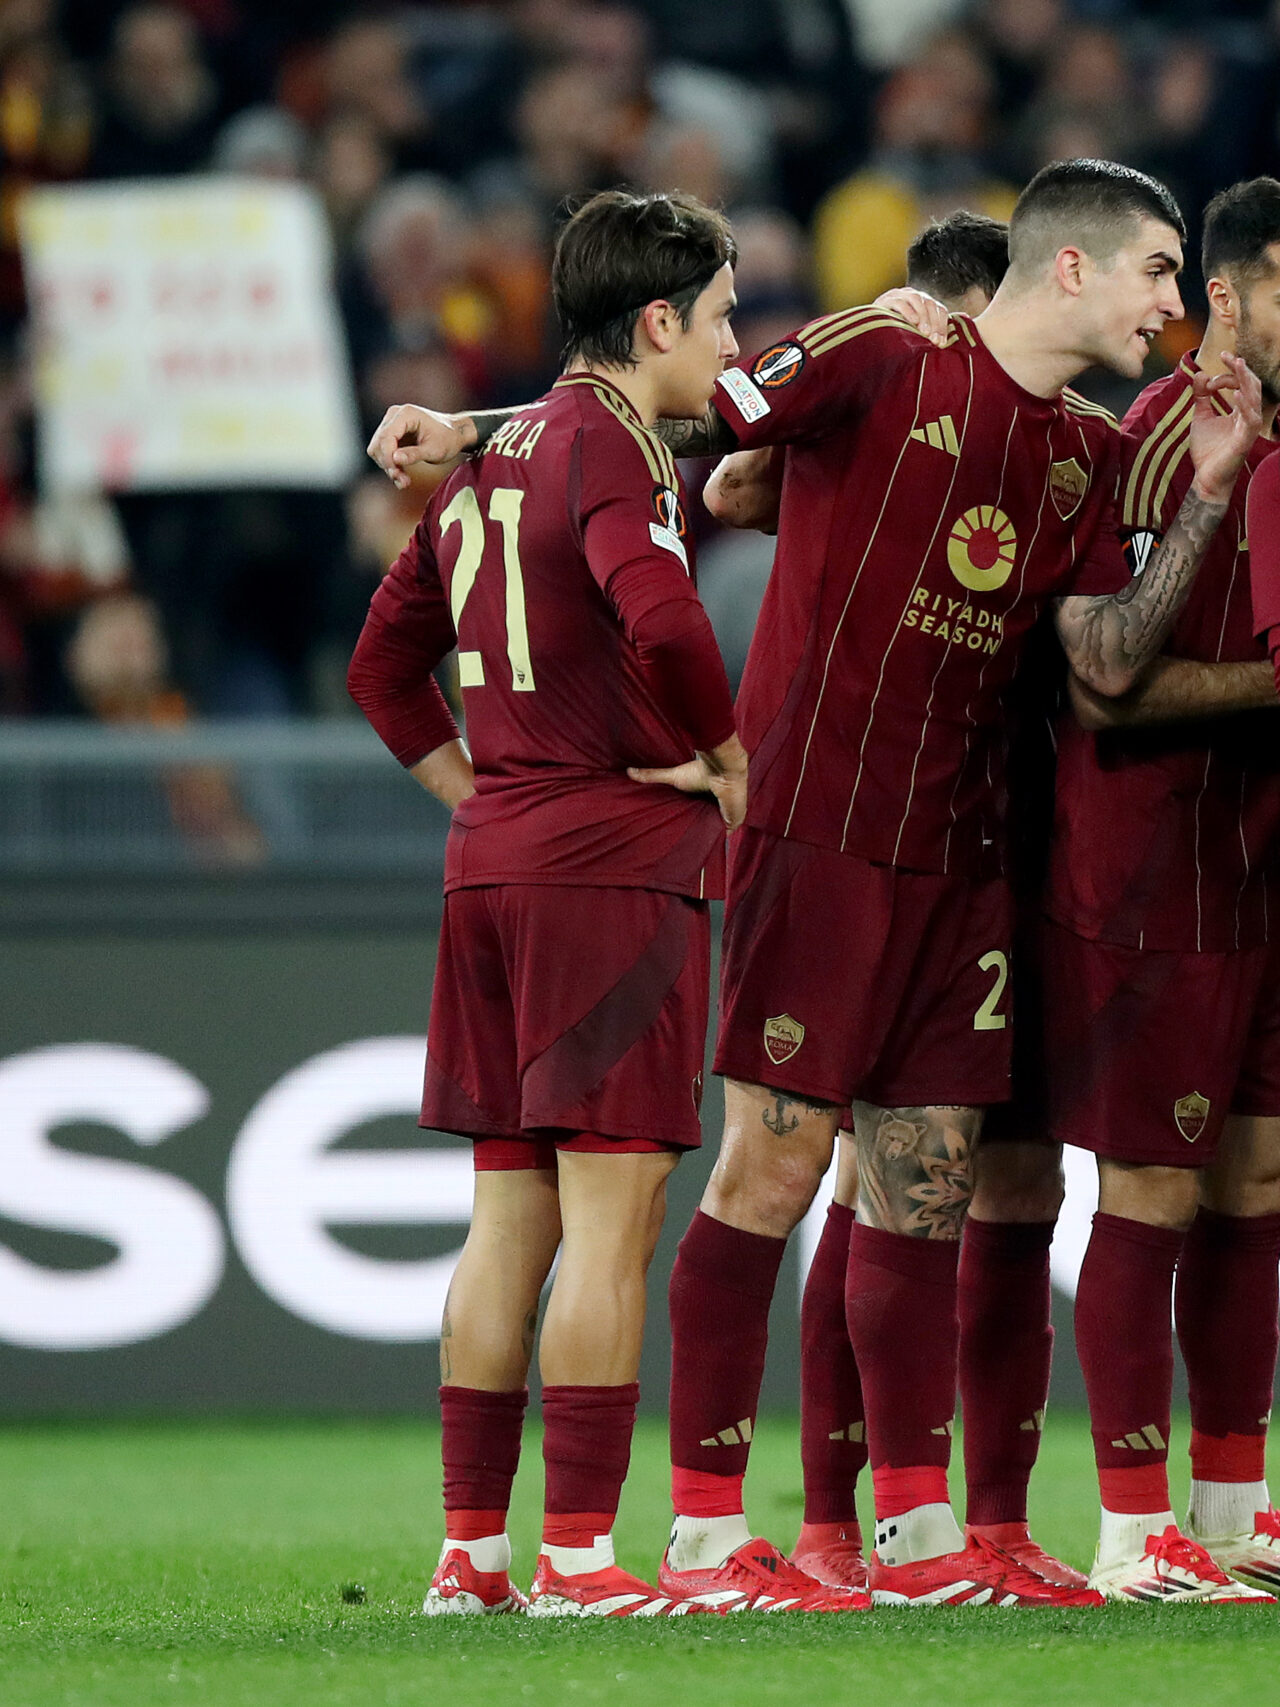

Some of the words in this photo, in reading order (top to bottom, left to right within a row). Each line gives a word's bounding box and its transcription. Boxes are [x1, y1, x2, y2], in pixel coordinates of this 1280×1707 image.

[438, 485, 536, 692] 21
[912, 587, 1002, 634] RIYADH
[903, 609, 1000, 655] SEASON
[973, 950, 1007, 1030] 2
